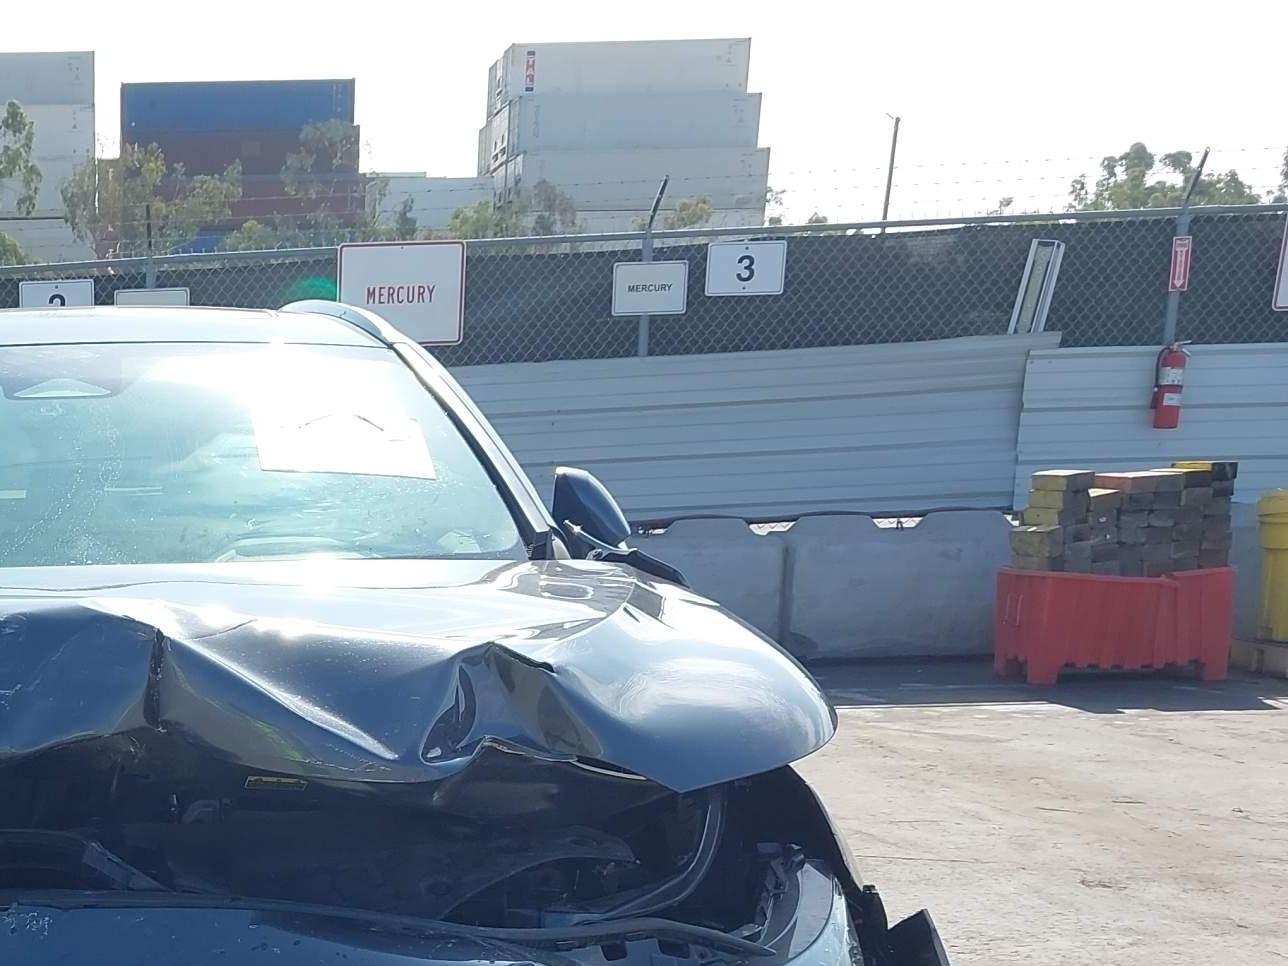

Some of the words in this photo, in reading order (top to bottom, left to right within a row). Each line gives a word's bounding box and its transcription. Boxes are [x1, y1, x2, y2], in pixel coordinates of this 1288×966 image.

[736, 254, 755, 282] 3
[366, 285, 436, 305] MERCURY
[627, 283, 673, 293] MERCURY
